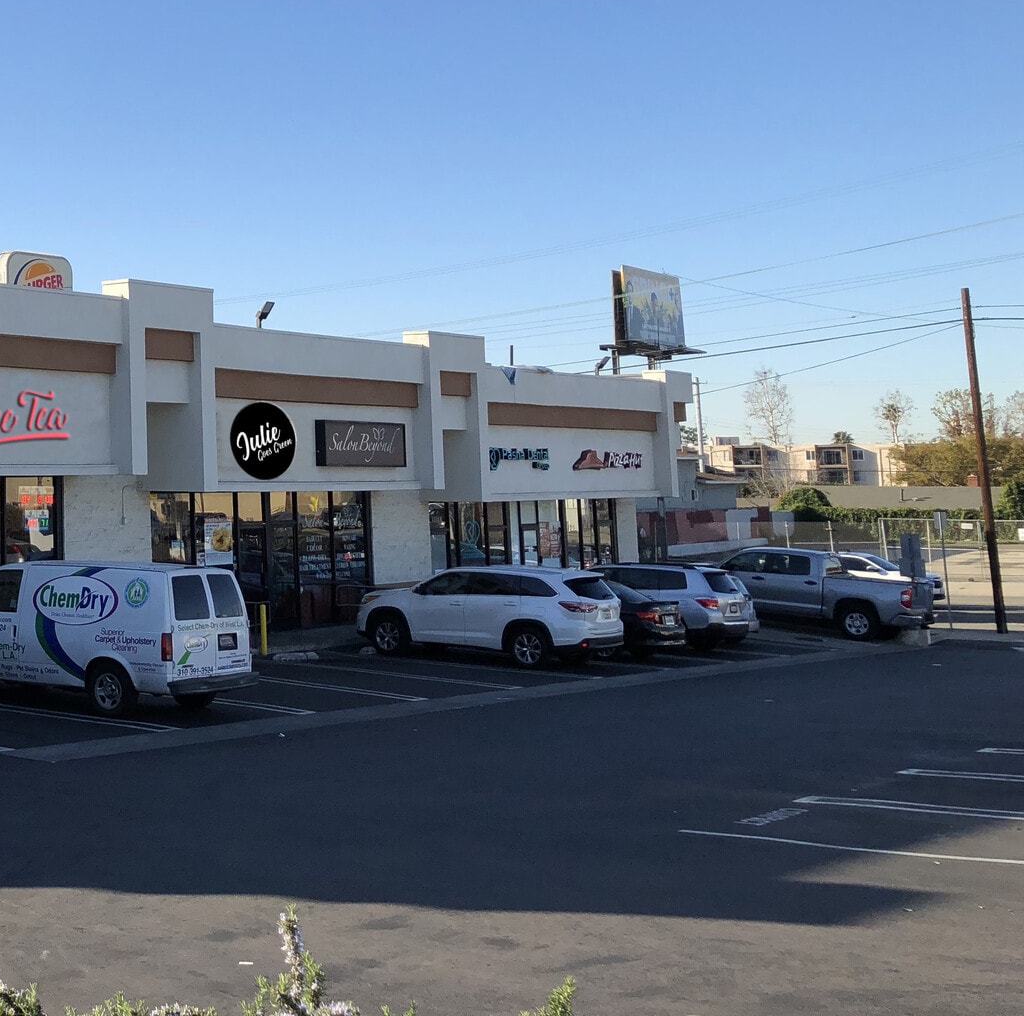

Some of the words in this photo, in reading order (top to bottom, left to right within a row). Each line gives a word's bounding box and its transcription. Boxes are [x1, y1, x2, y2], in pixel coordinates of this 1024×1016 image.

[17, 390, 69, 431] Tea
[236, 422, 281, 461] Julie
[328, 425, 359, 452] Salon
[359, 427, 400, 463] Beyond
[257, 446, 273, 461] Goes
[273, 438, 293, 454] Green
[609, 452, 629, 468] Pizza
[629, 453, 643, 469] Hut
[100, 628, 125, 638] Superior
[177, 624, 194, 632] Select
[194, 622, 219, 632] Chem-Dry
[94, 635, 116, 645] Carpet
[116, 636, 121, 644] &
[122, 636, 157, 647] Upholstery
[2, 650, 18, 660] L.A.
[111, 643, 138, 654] Cleaning
